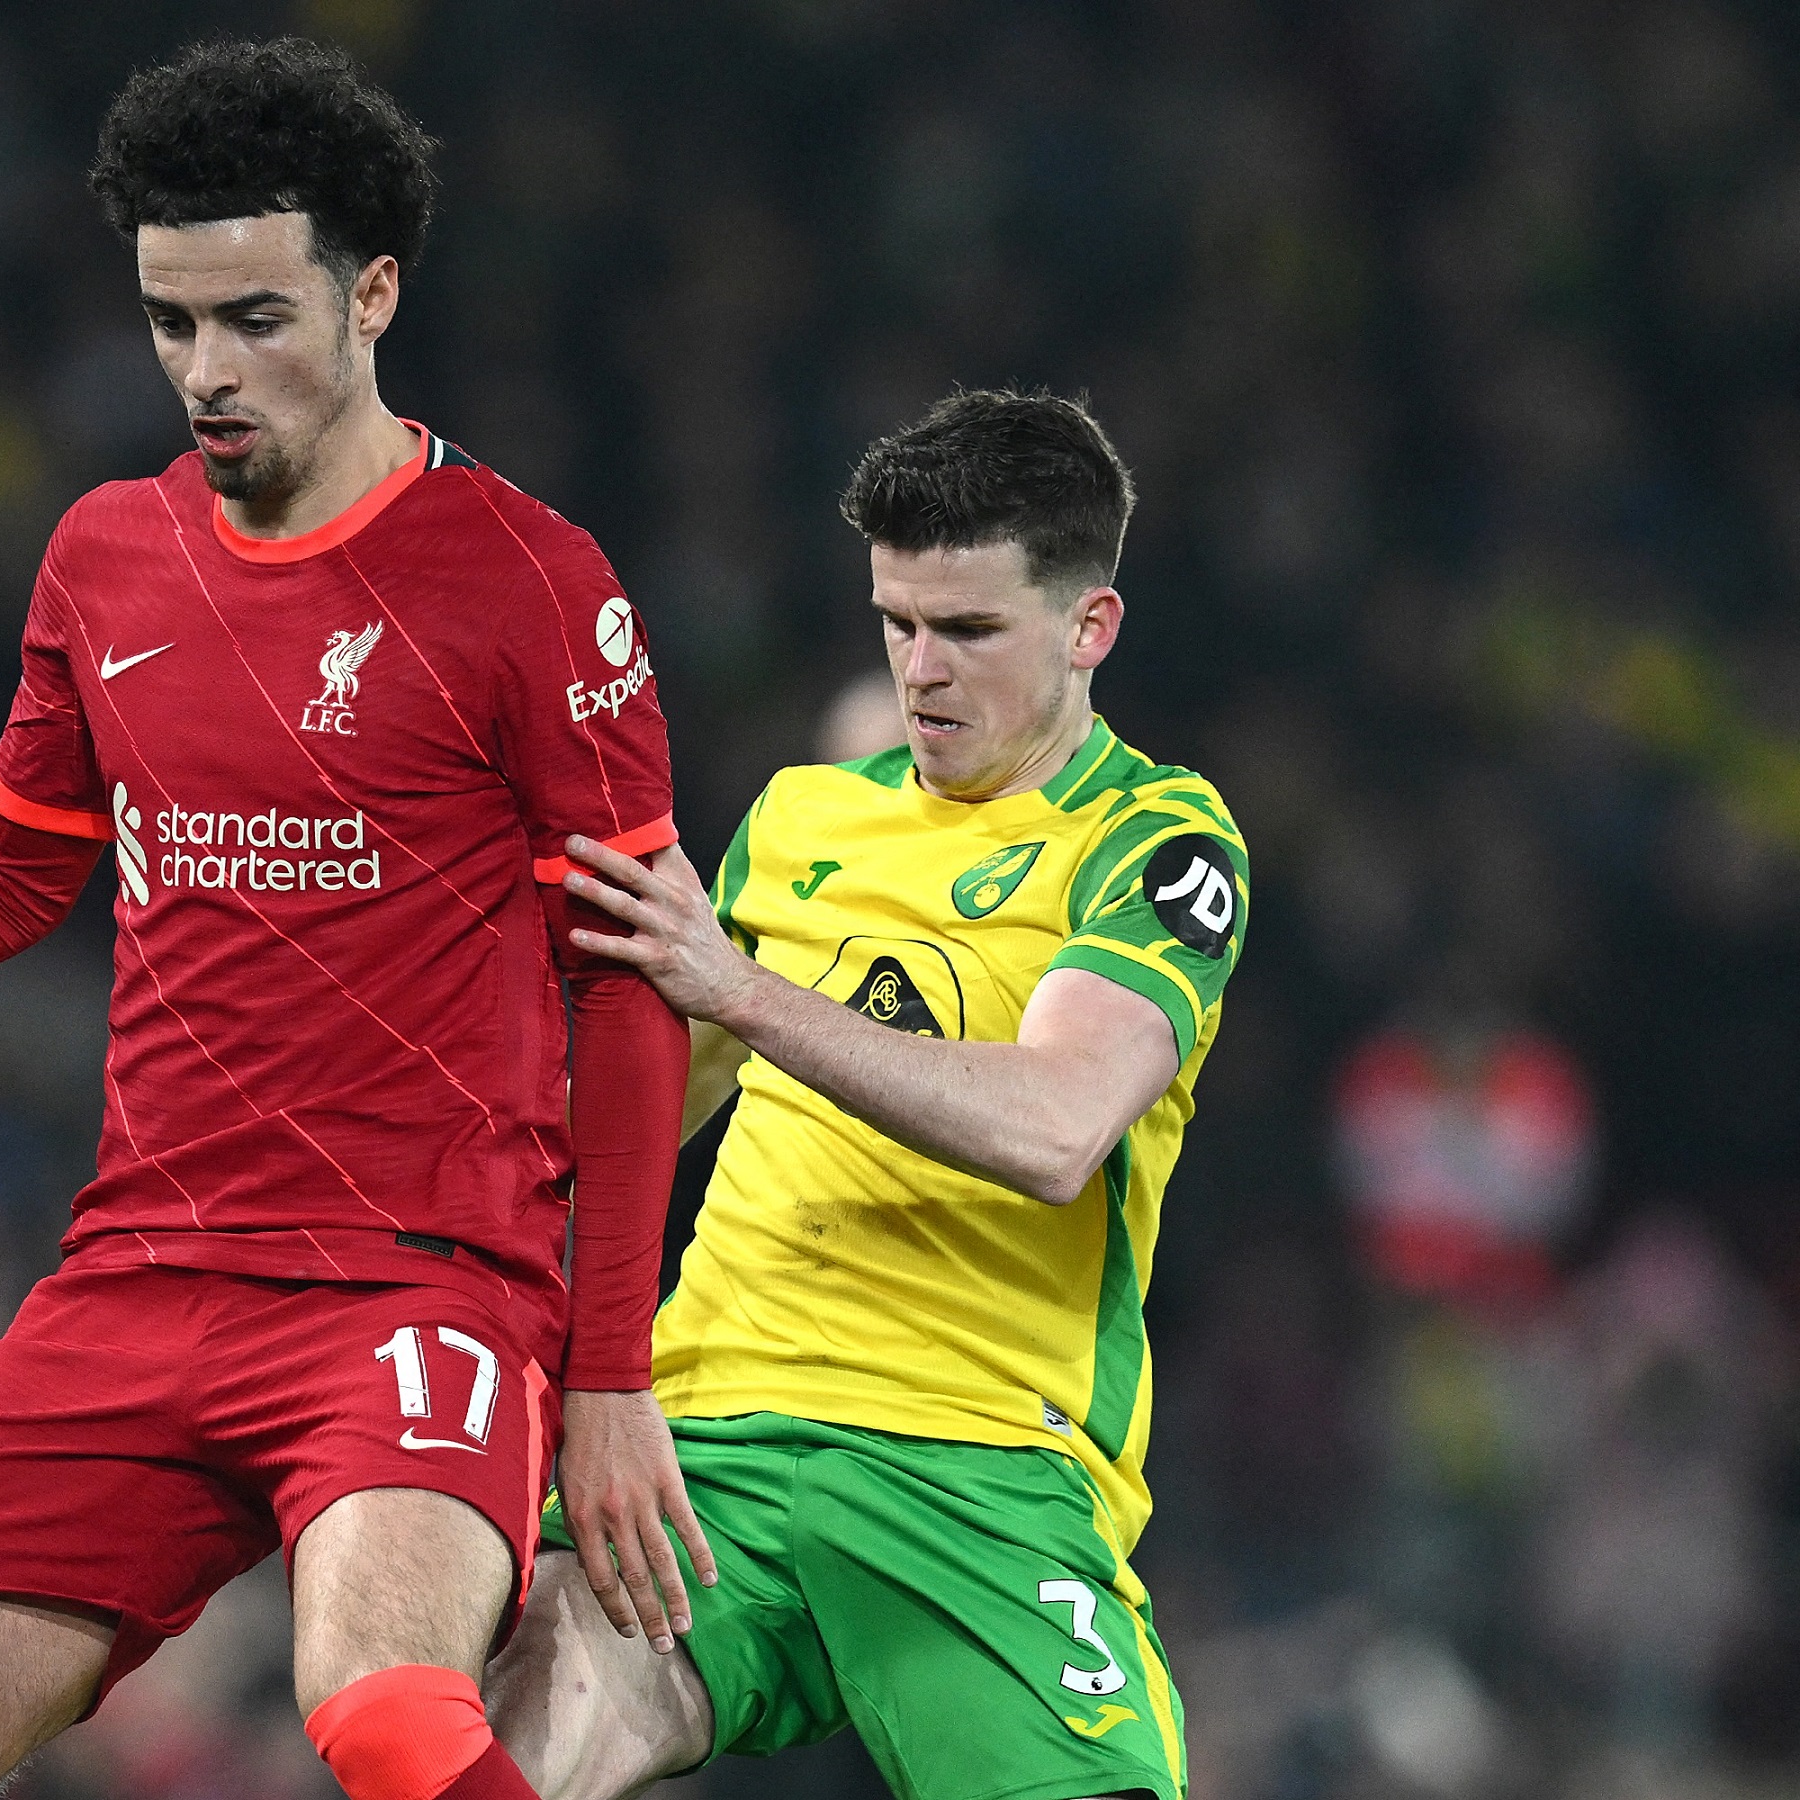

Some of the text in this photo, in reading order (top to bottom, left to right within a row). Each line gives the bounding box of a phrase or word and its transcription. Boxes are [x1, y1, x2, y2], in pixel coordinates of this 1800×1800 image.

[156, 802, 365, 850] standard
[160, 846, 381, 891] chartered
[1154, 855, 1233, 934] JD
[374, 1326, 500, 1446] 17
[1038, 1578, 1128, 1696] 3
